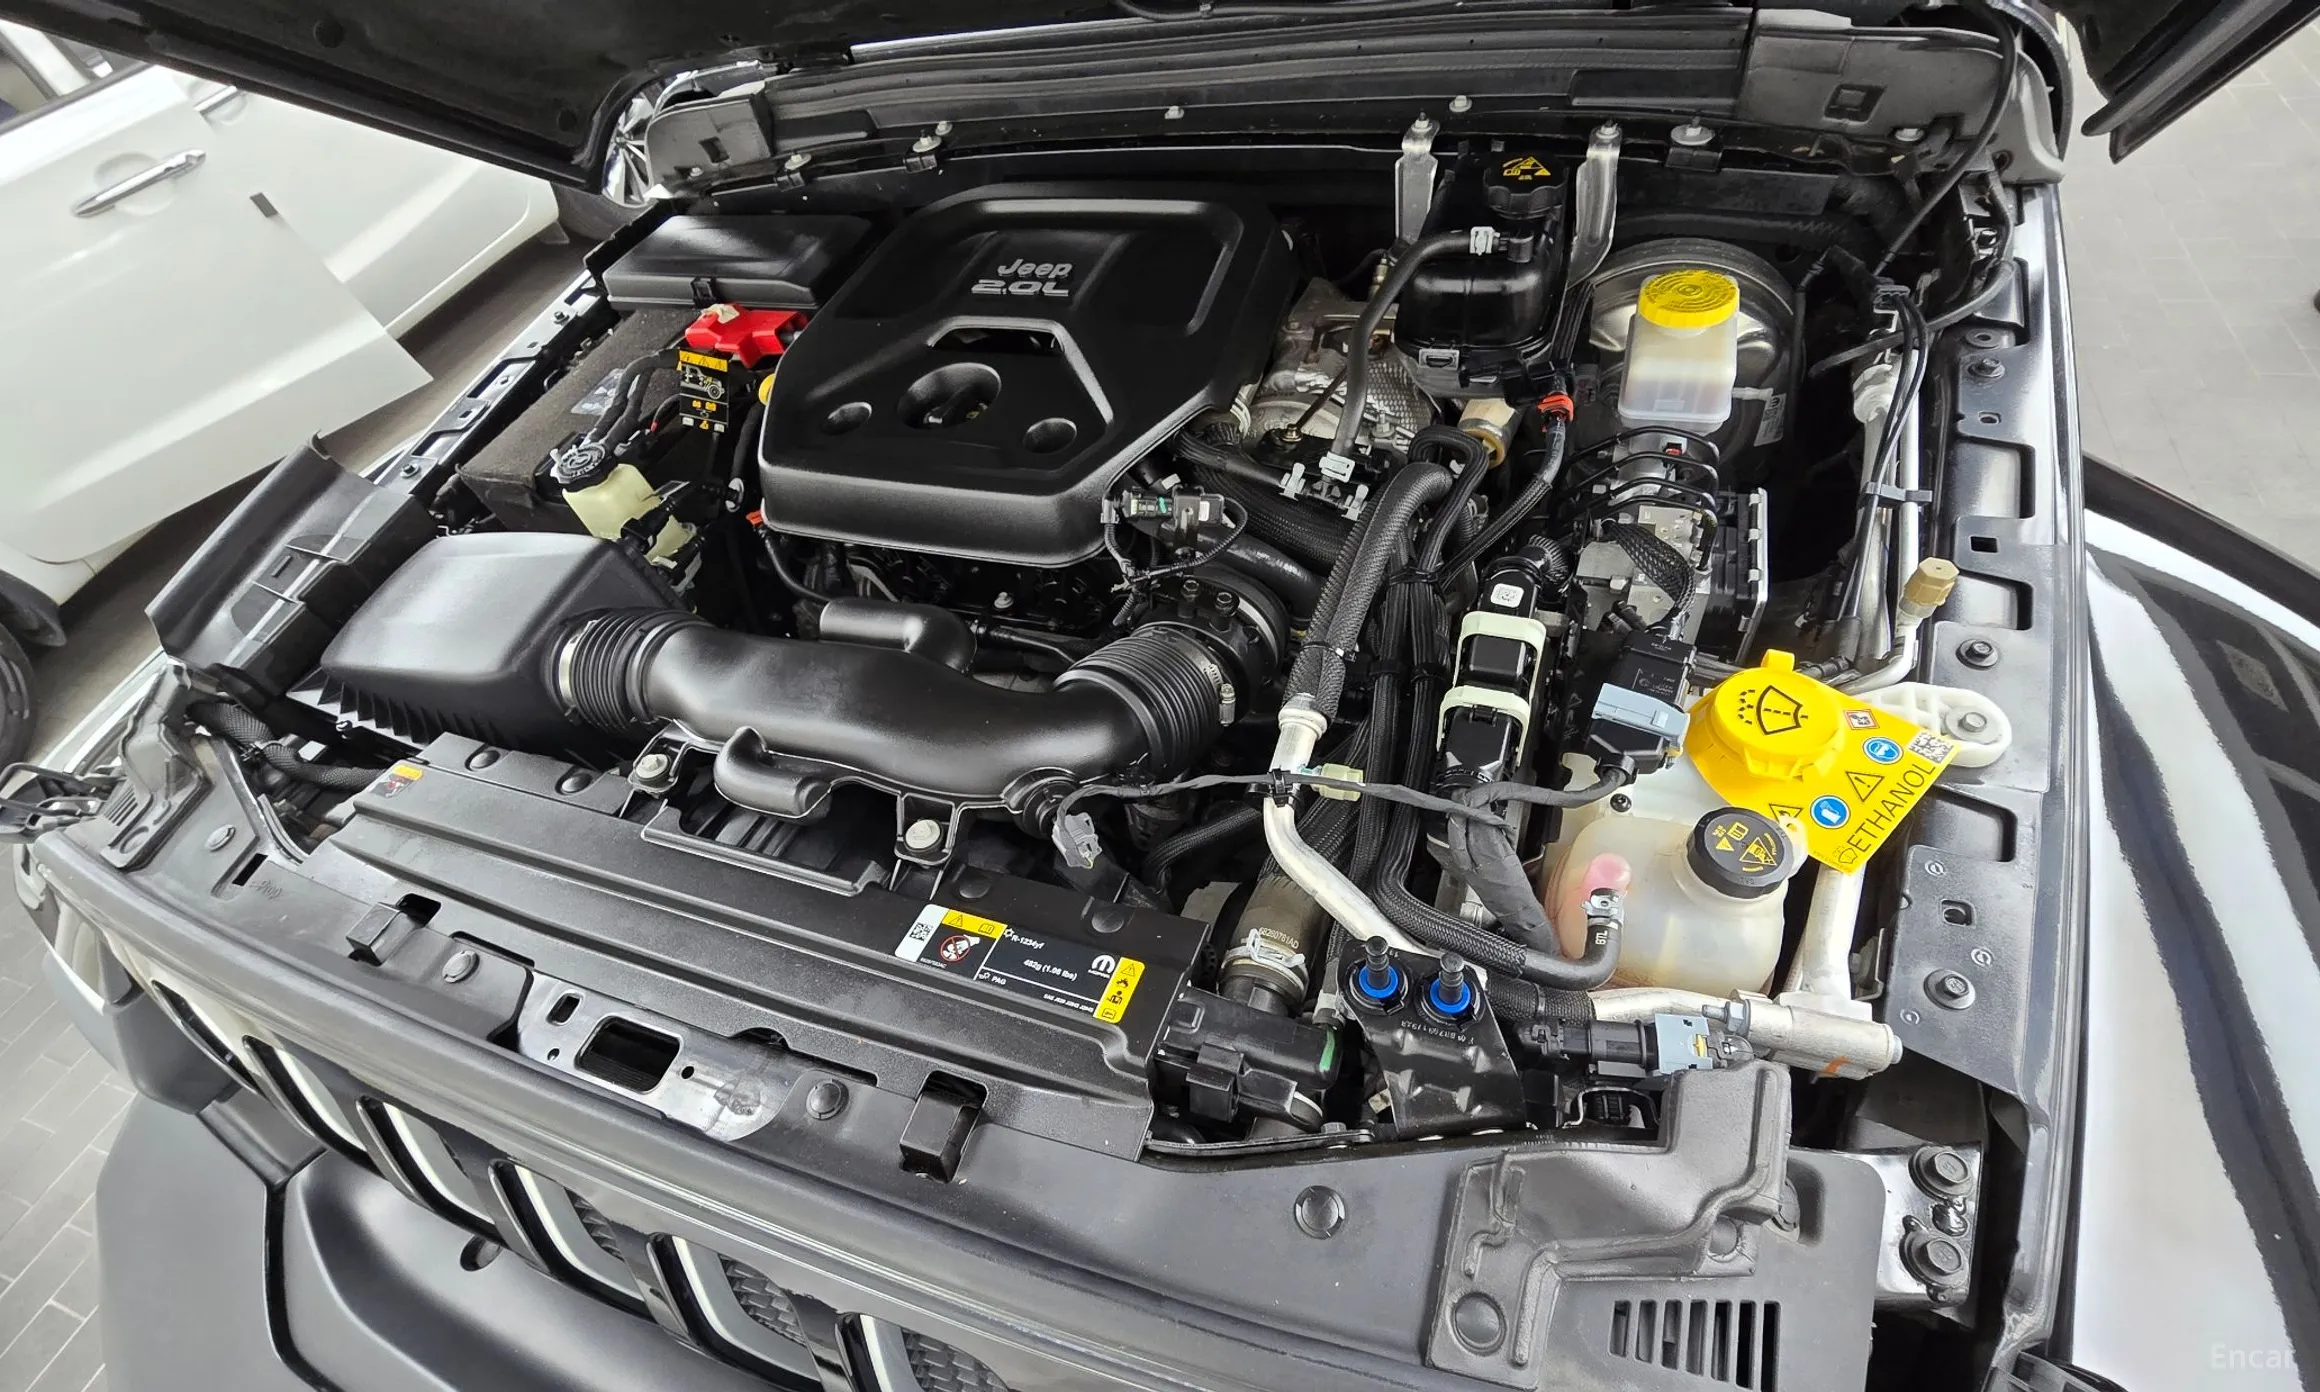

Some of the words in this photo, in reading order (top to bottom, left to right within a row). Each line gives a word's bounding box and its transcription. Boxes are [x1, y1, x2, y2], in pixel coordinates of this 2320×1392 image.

[997, 259, 1073, 278] Jeep
[971, 279, 1069, 296] 2.0L
[1847, 763, 1936, 854] ETHANOL
[1011, 934, 1045, 949] R-1234yf
[991, 976, 1007, 985] PAG
